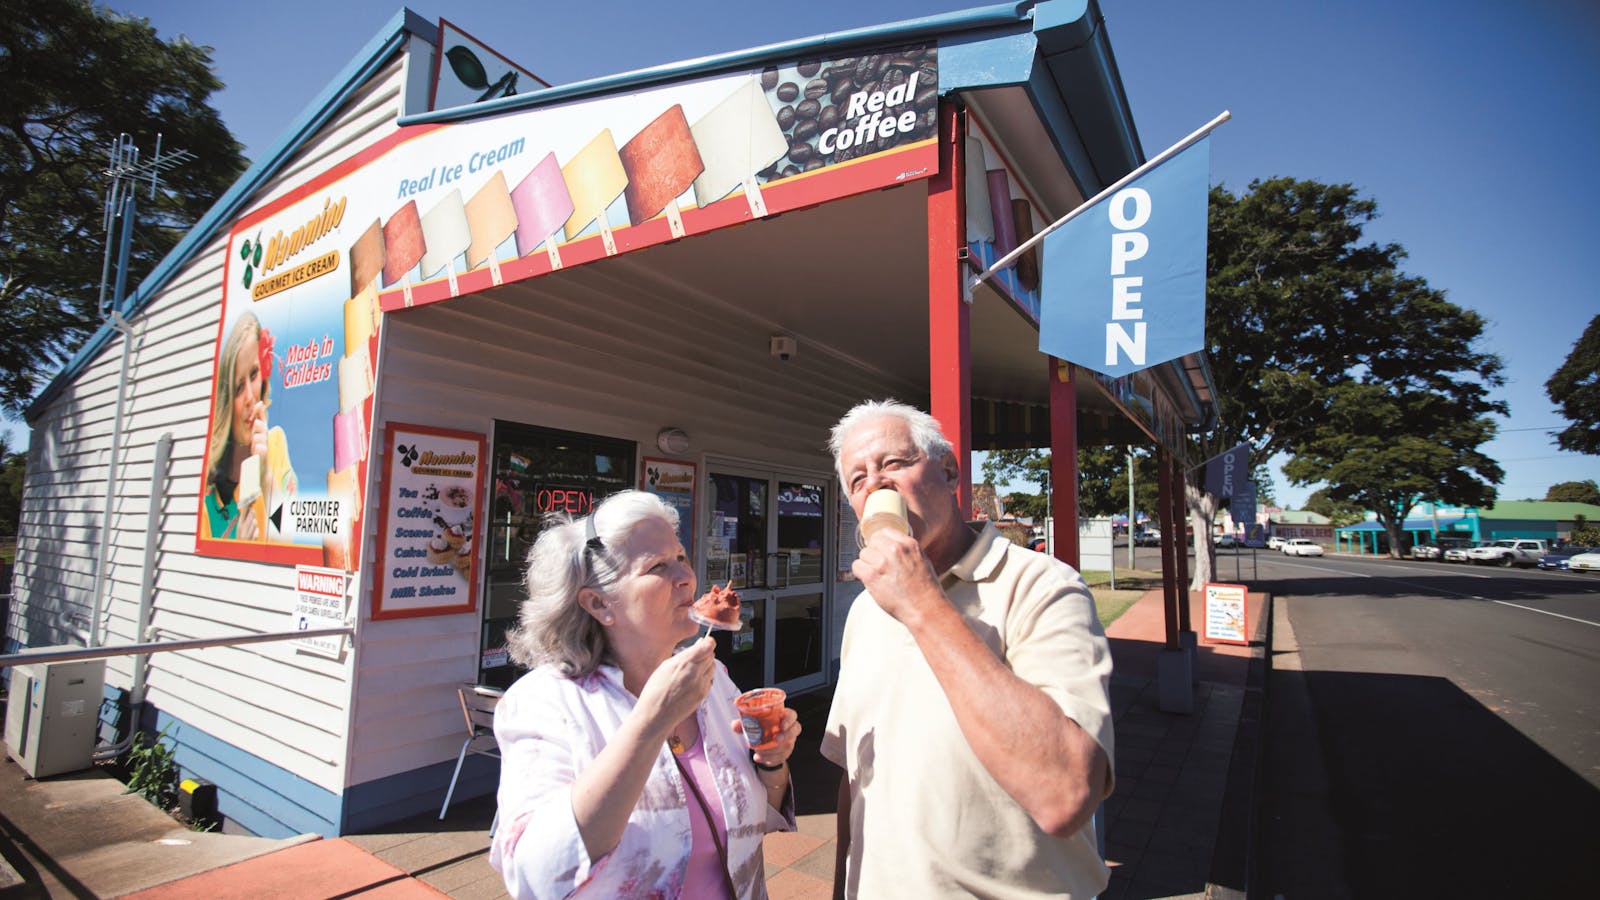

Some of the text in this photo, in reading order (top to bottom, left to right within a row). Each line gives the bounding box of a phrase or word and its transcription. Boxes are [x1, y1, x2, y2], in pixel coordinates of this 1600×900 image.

[846, 71, 920, 121] Real
[819, 110, 917, 155] Coffee
[397, 137, 525, 199] Real Ice Cream
[255, 254, 335, 297] GOURMET ICE CREAM
[1105, 187, 1152, 366] OPEN
[286, 336, 334, 366] Made in
[283, 361, 332, 389] Childers
[1222, 454, 1235, 496] OPEN
[398, 488, 418, 498] Tea
[537, 490, 593, 513] OPEN
[290, 500, 339, 517] CUSTOMER
[296, 517, 338, 534] PARKING
[394, 547, 427, 558] Cakes
[300, 573, 343, 594] WARNING
[392, 566, 454, 578] Cold Drinks
[391, 586, 456, 599] Milk Shakes
